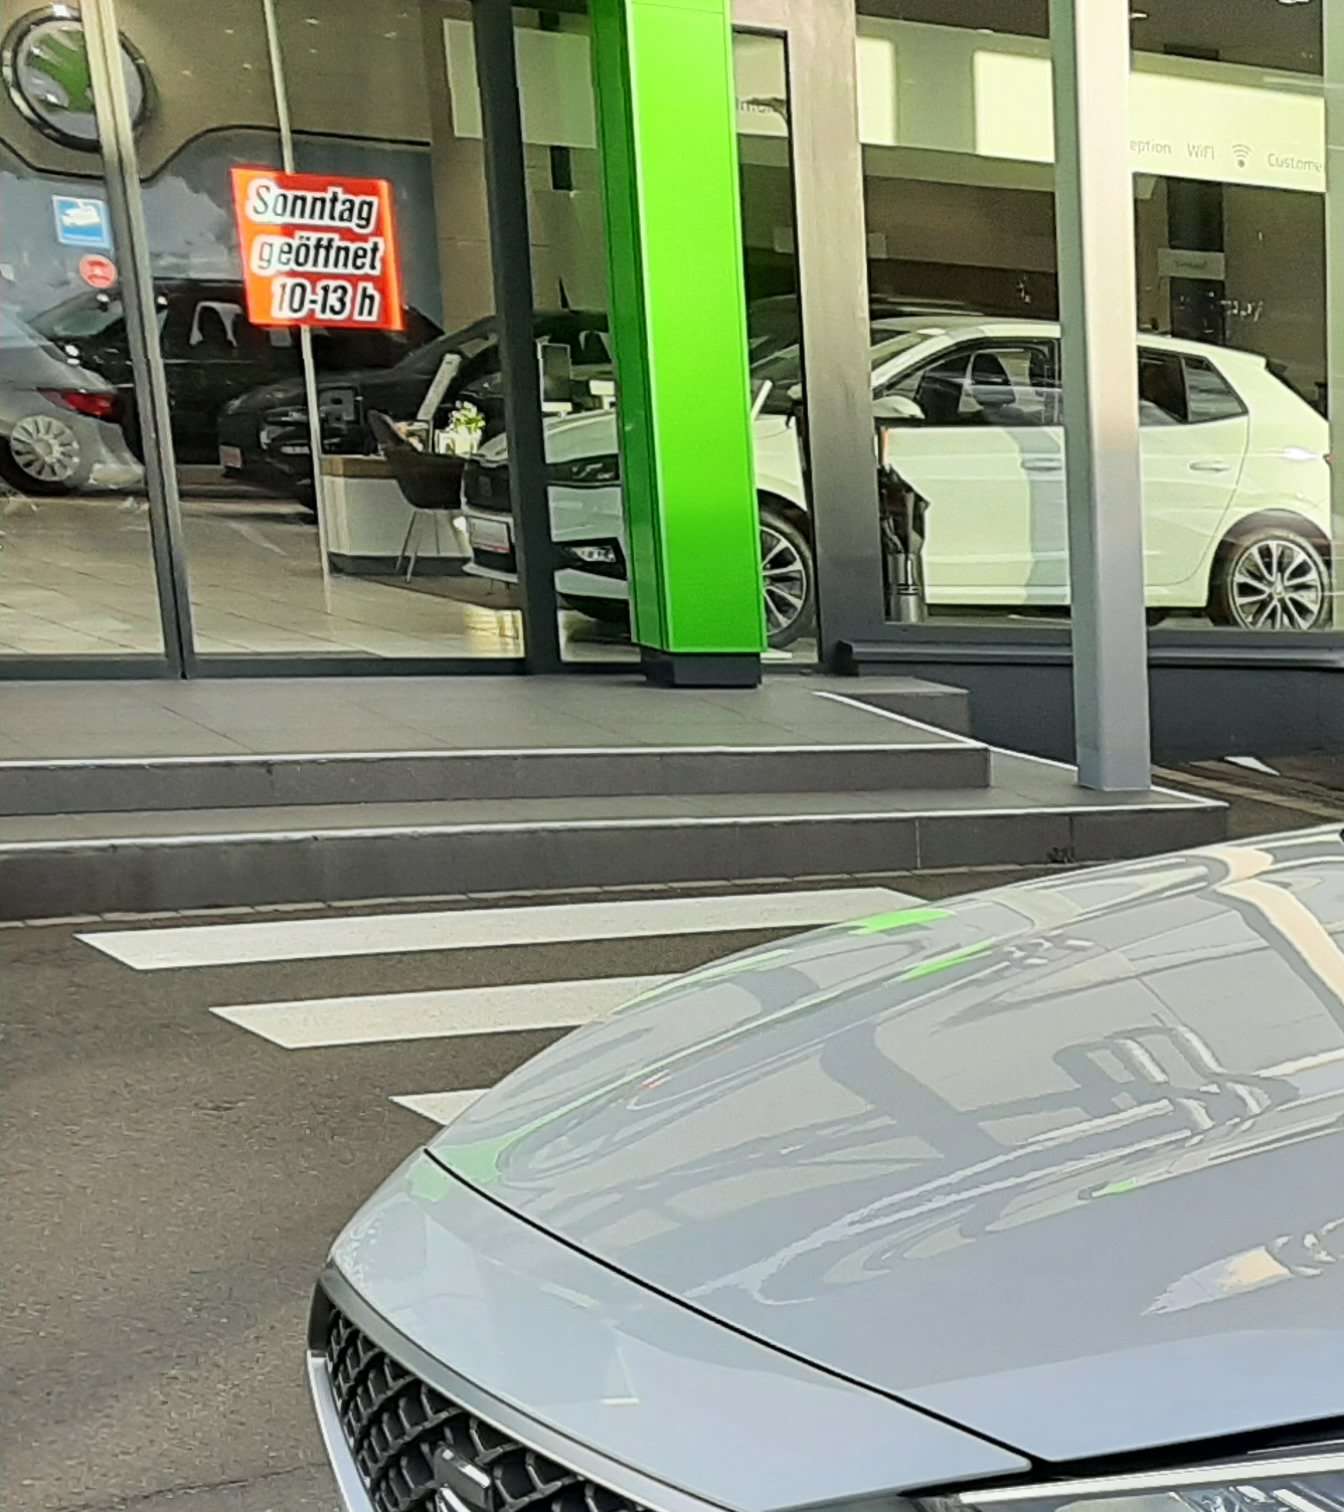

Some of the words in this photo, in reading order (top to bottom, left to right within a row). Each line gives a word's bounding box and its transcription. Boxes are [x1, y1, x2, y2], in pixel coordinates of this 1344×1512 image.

[253, 185, 374, 229] Sonntag
[258, 235, 380, 271] geöffnet
[278, 282, 348, 315] 10-13
[358, 286, 376, 317] h
